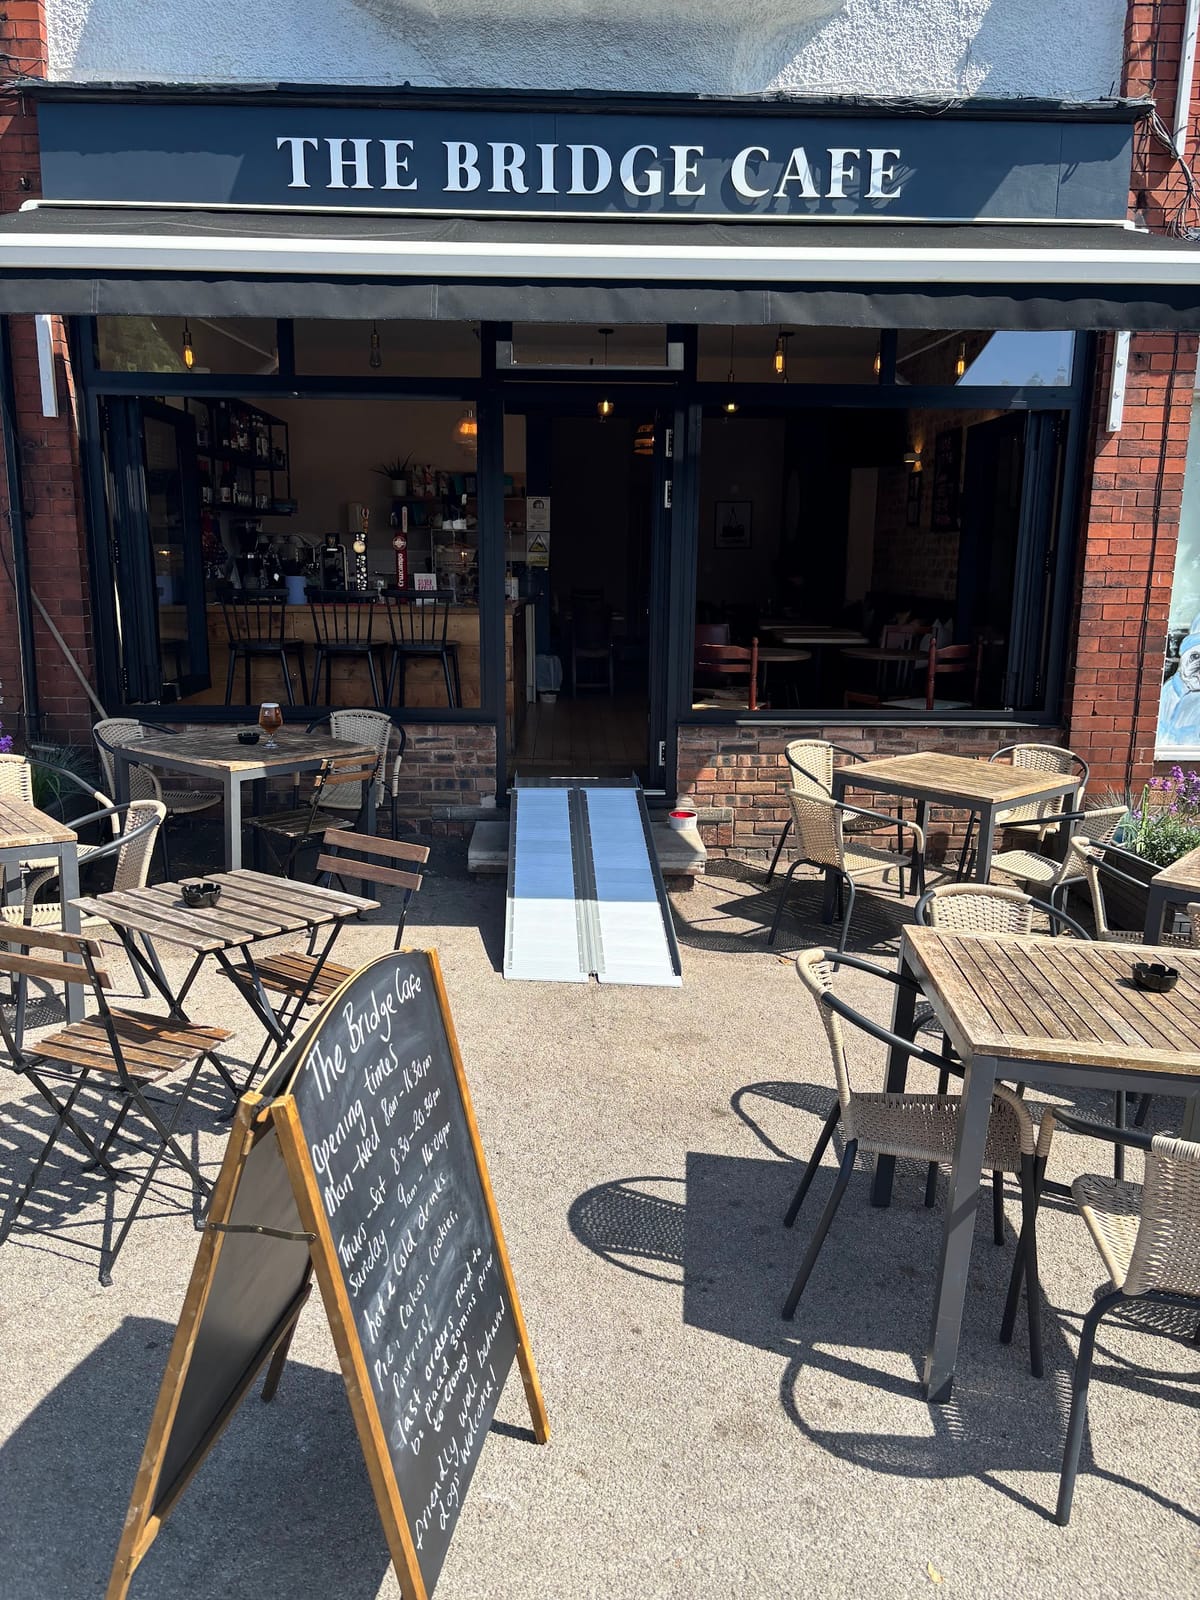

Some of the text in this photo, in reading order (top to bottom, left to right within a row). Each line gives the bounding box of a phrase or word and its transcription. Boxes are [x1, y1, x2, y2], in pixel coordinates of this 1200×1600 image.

[276, 136, 902, 200] THE BRIDGE CAFE
[306, 968, 422, 1101] The Bridge Cafe
[312, 1043, 399, 1184] Opening times
[324, 1173, 354, 1217] Mon
[381, 1095, 398, 1127] 8am
[338, 1221, 367, 1268] Thurs
[349, 1229, 390, 1297] Sunday
[397, 1182, 418, 1209] 9am
[363, 1291, 386, 1344] hot
[410, 1429, 424, 1456] be
[424, 1356, 450, 1425] placed
[477, 1252, 493, 1292] prior
[424, 1315, 454, 1382] orders
[454, 1261, 473, 1308] need
[472, 1247, 482, 1264] to
[476, 1295, 507, 1369] behaved
[432, 1408, 444, 1433] to
[438, 1471, 461, 1531] dogs
